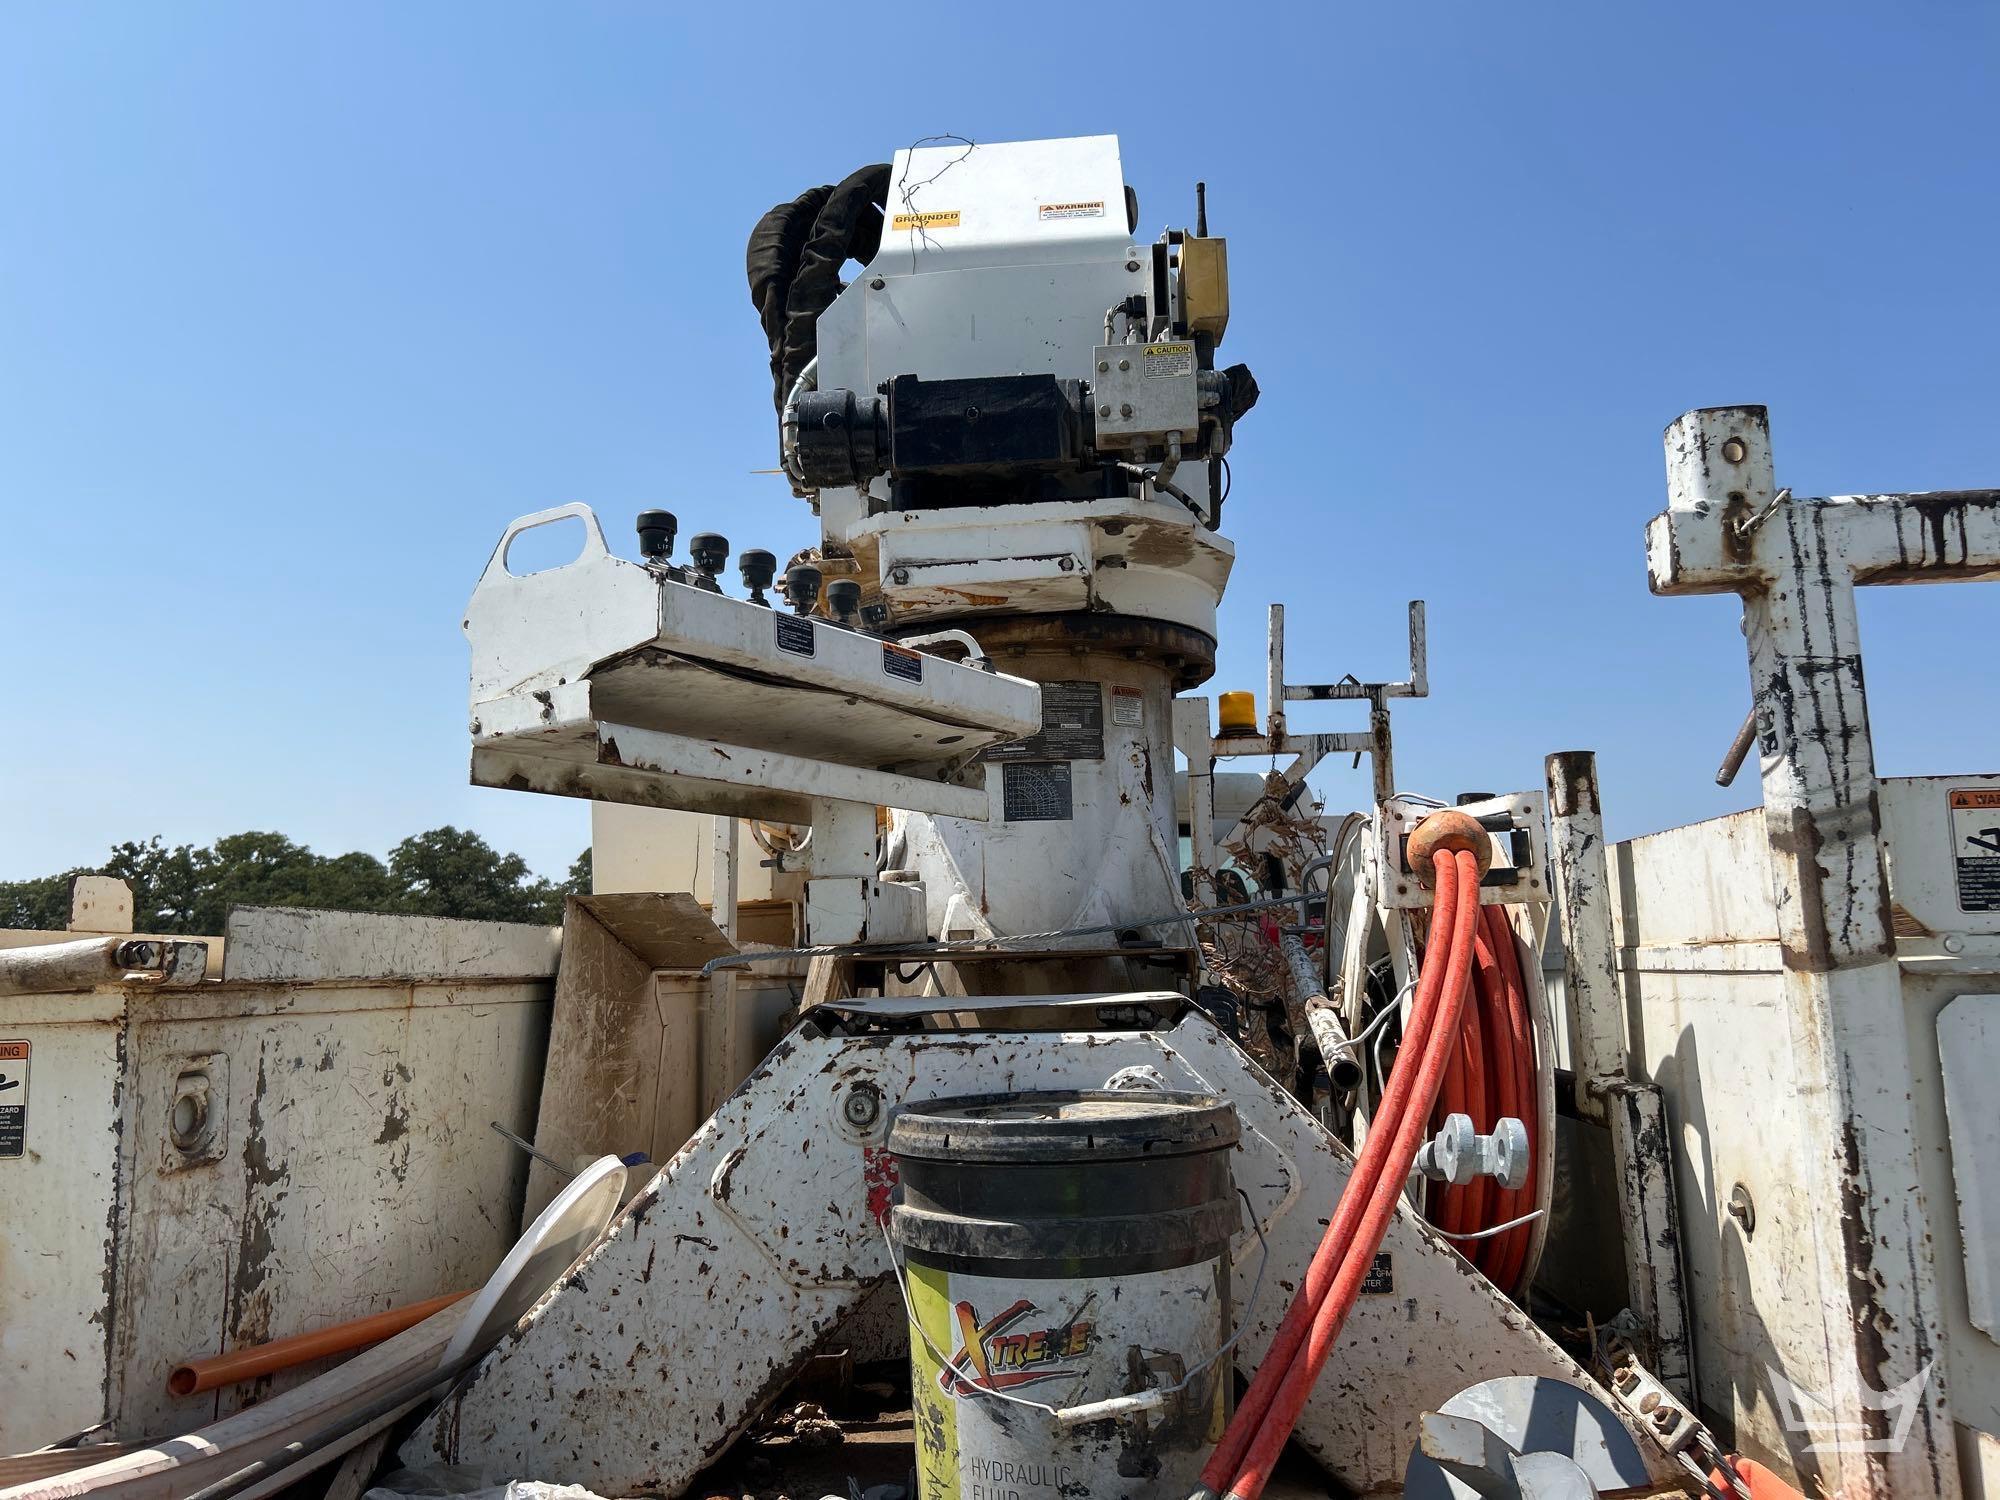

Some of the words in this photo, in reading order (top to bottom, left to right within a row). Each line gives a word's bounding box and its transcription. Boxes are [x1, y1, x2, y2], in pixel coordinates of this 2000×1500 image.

[1055, 202, 1100, 210] WARNING
[895, 213, 959, 223] GROUNDED
[1156, 346, 1189, 354] CAUTION
[1360, 1279, 1382, 1288] NTER
[940, 1298, 1096, 1394] XTREE
[971, 1456, 1072, 1487] HYDRAULIC
